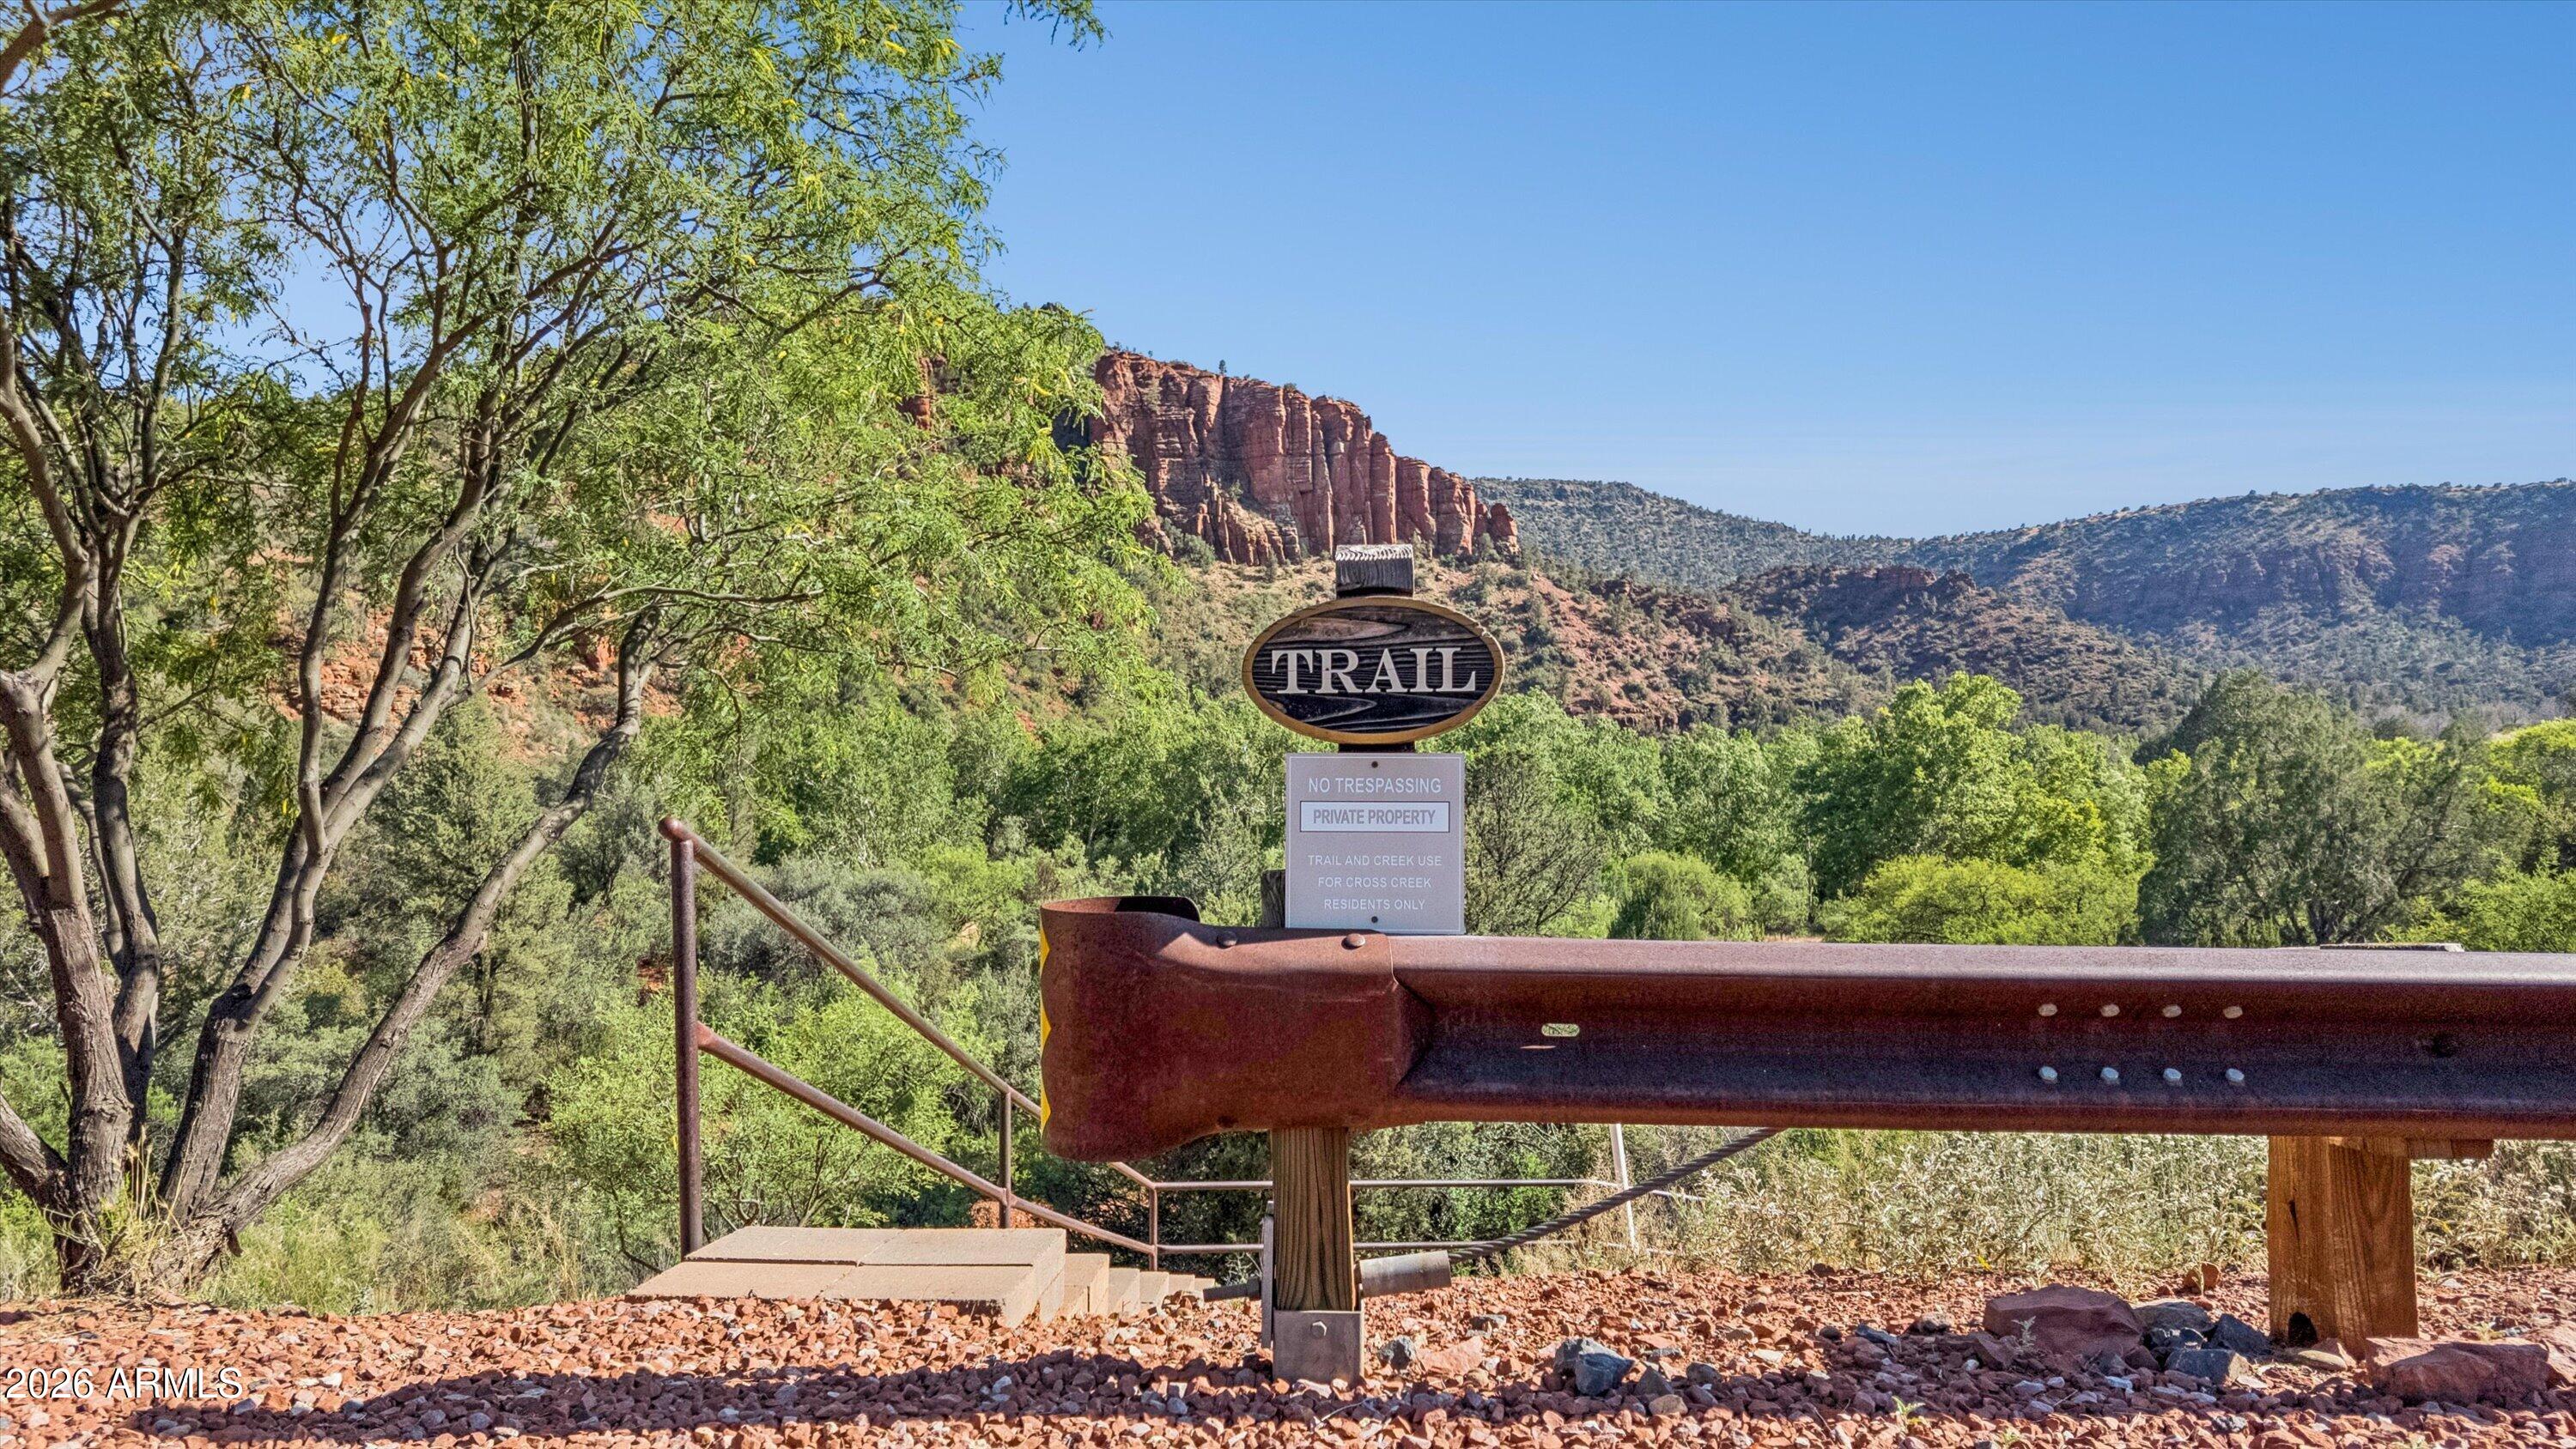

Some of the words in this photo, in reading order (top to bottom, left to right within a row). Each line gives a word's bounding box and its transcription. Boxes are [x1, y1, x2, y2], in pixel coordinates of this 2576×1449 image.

[1272, 647, 1476, 694] TRAIL
[1309, 778, 1330, 793] NO
[1335, 778, 1442, 793] TRESPASSING
[1313, 809, 1364, 824] PRIVATE
[1368, 809, 1436, 824] PROPERTY
[1308, 855, 1341, 866] TRAIL
[1345, 855, 1370, 866] AND
[1374, 855, 1414, 866] CREEK
[1418, 855, 1443, 866] USE
[1318, 877, 1342, 888] FOR
[1346, 877, 1387, 888] CROSS
[1391, 877, 1431, 888] CREEK
[1324, 899, 1390, 910] RESIDENTS
[1394, 899, 1425, 910] ONLY
